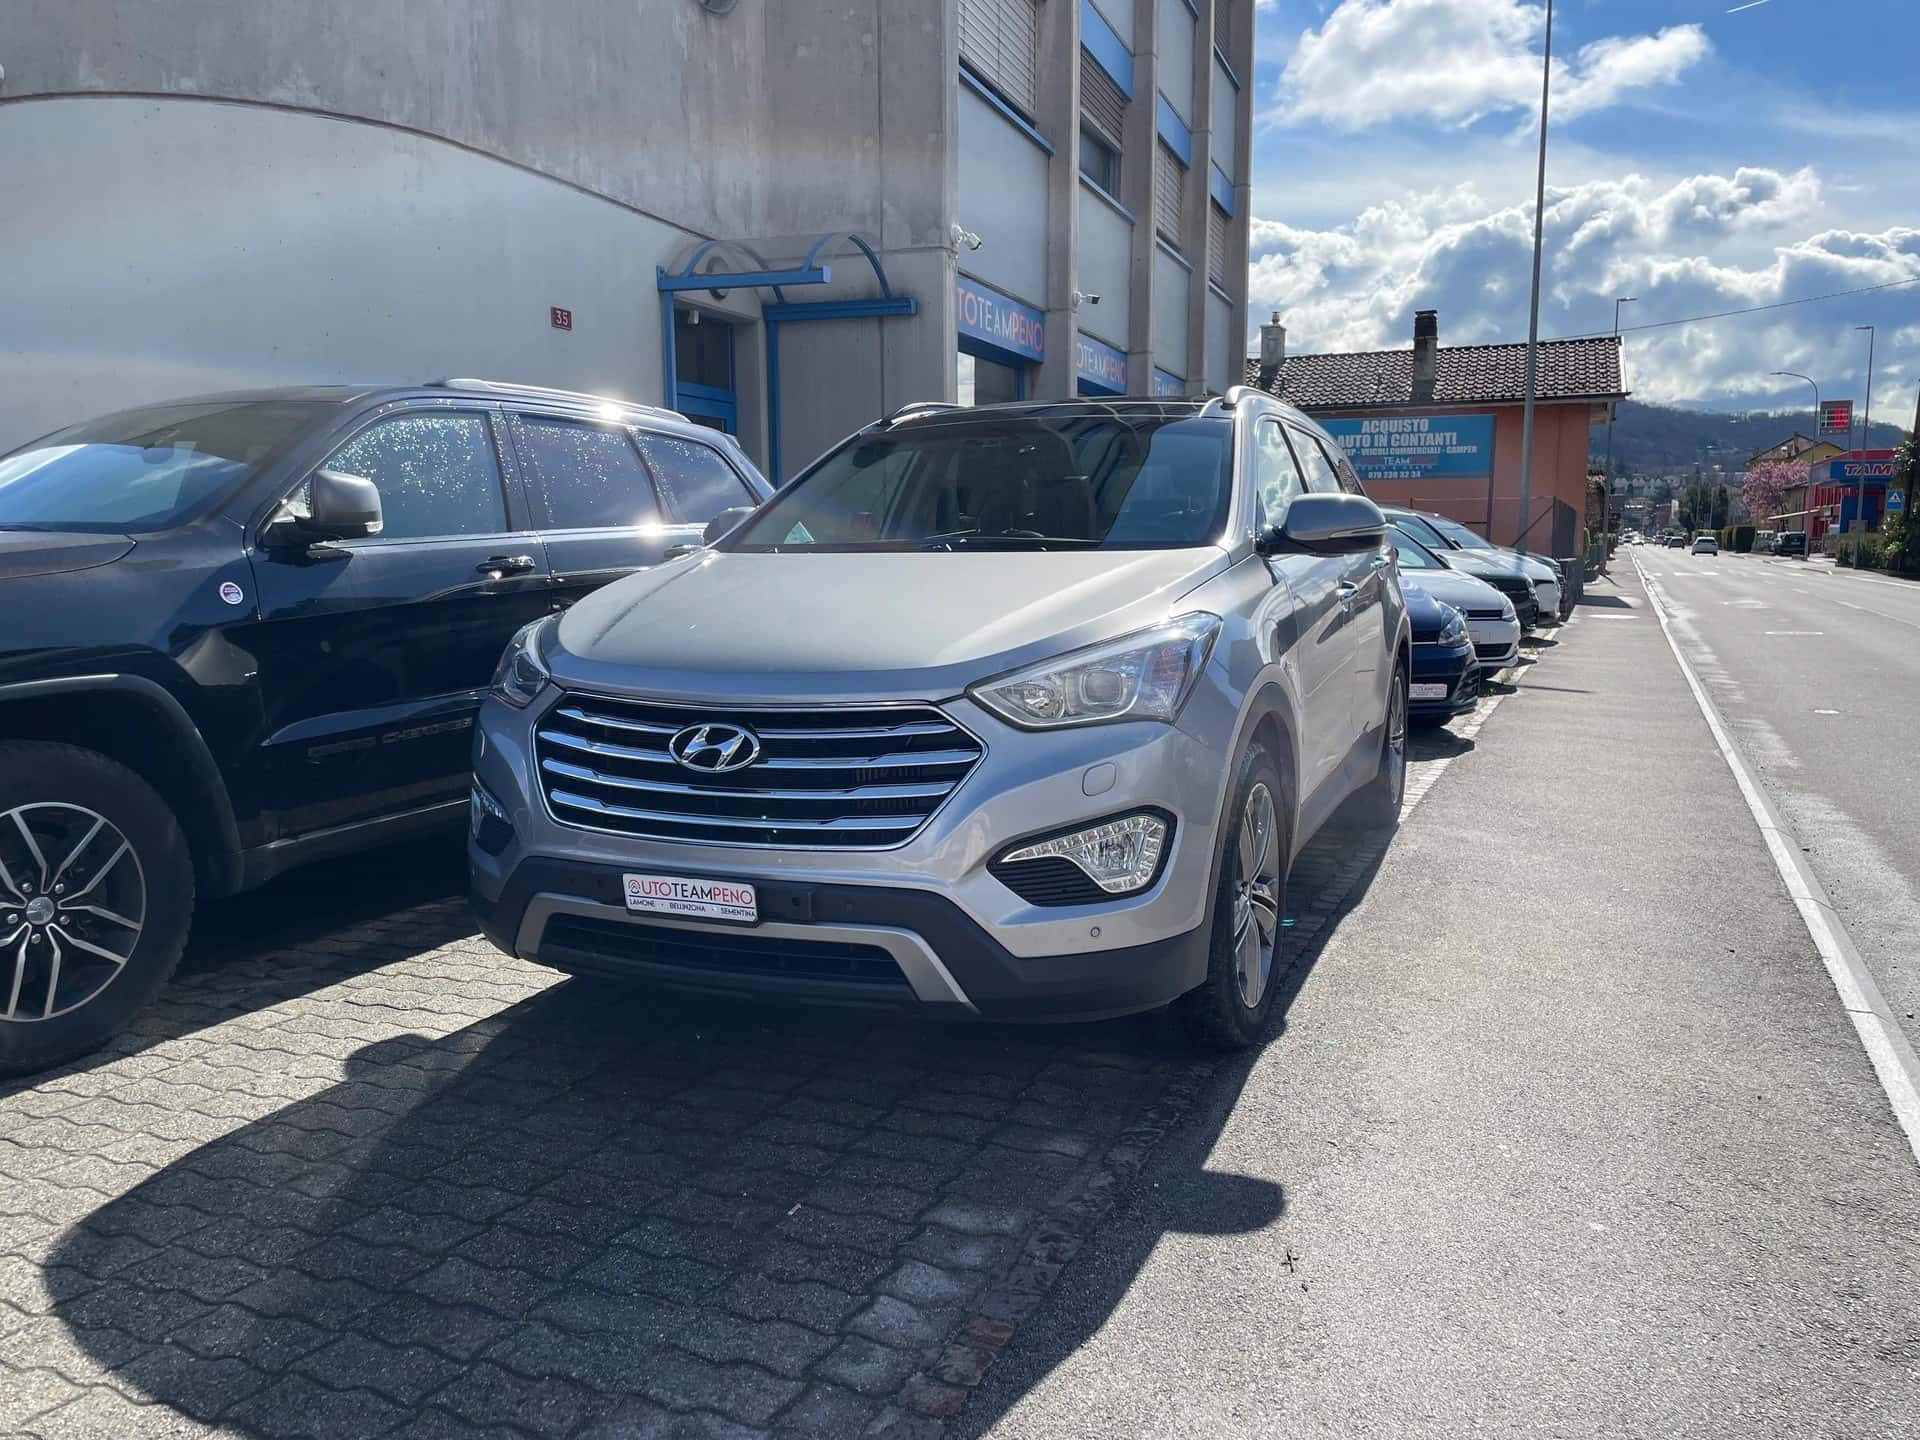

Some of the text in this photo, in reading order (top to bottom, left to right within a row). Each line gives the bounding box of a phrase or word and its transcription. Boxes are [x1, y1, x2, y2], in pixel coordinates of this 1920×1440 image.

[555, 310, 569, 326] 35
[1361, 418, 1430, 435] ACQUISTO
[1337, 432, 1457, 449] AUTO IN CONTANTI
[1361, 447, 1389, 456] VEICOLI
[1390, 446, 1441, 455] COMMERCIALI
[1446, 445, 1478, 454] CAMPER
[1384, 456, 1410, 465] TEAM
[1845, 463, 1897, 477] TAM
[629, 898, 756, 917] LAMONE BELLINZONA SEMENTINA
